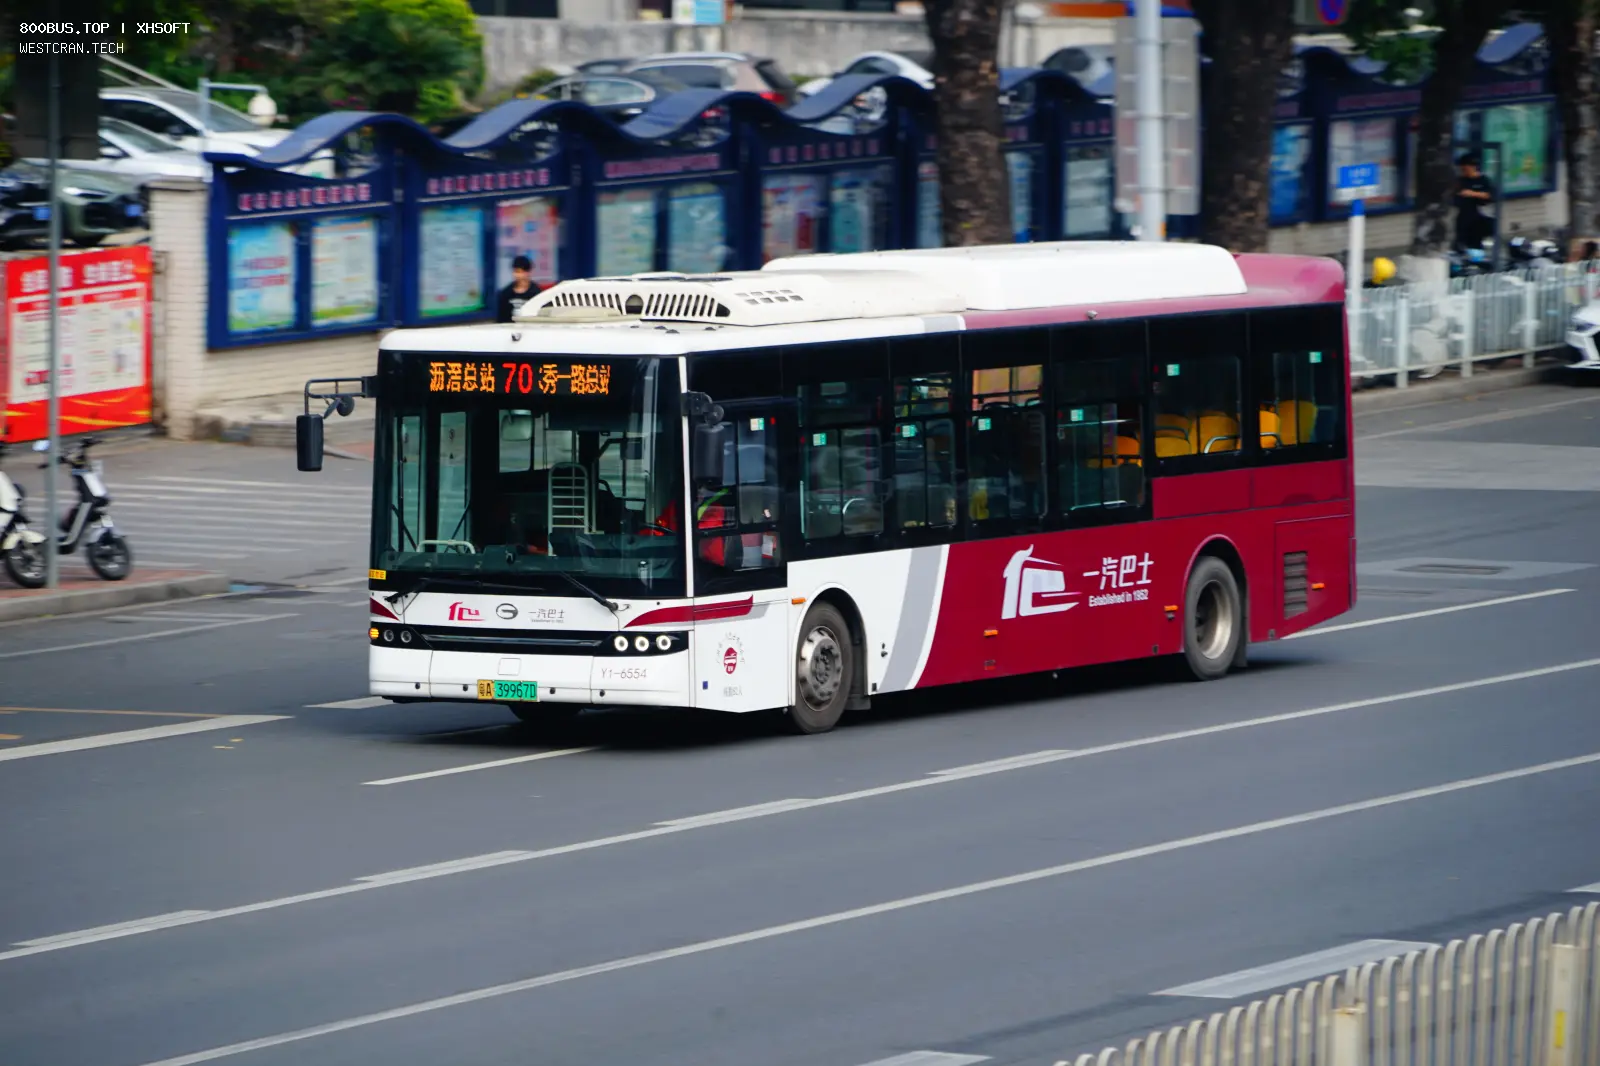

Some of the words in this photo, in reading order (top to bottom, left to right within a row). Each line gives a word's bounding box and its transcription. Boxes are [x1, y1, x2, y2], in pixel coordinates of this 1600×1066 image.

[429, 361, 496, 393] 沥滘总站
[502, 362, 534, 394] 70
[1082, 552, 1155, 590] 一汽巴士
[601, 668, 647, 679] Y1-6554
[497, 683, 536, 698] 39967D
